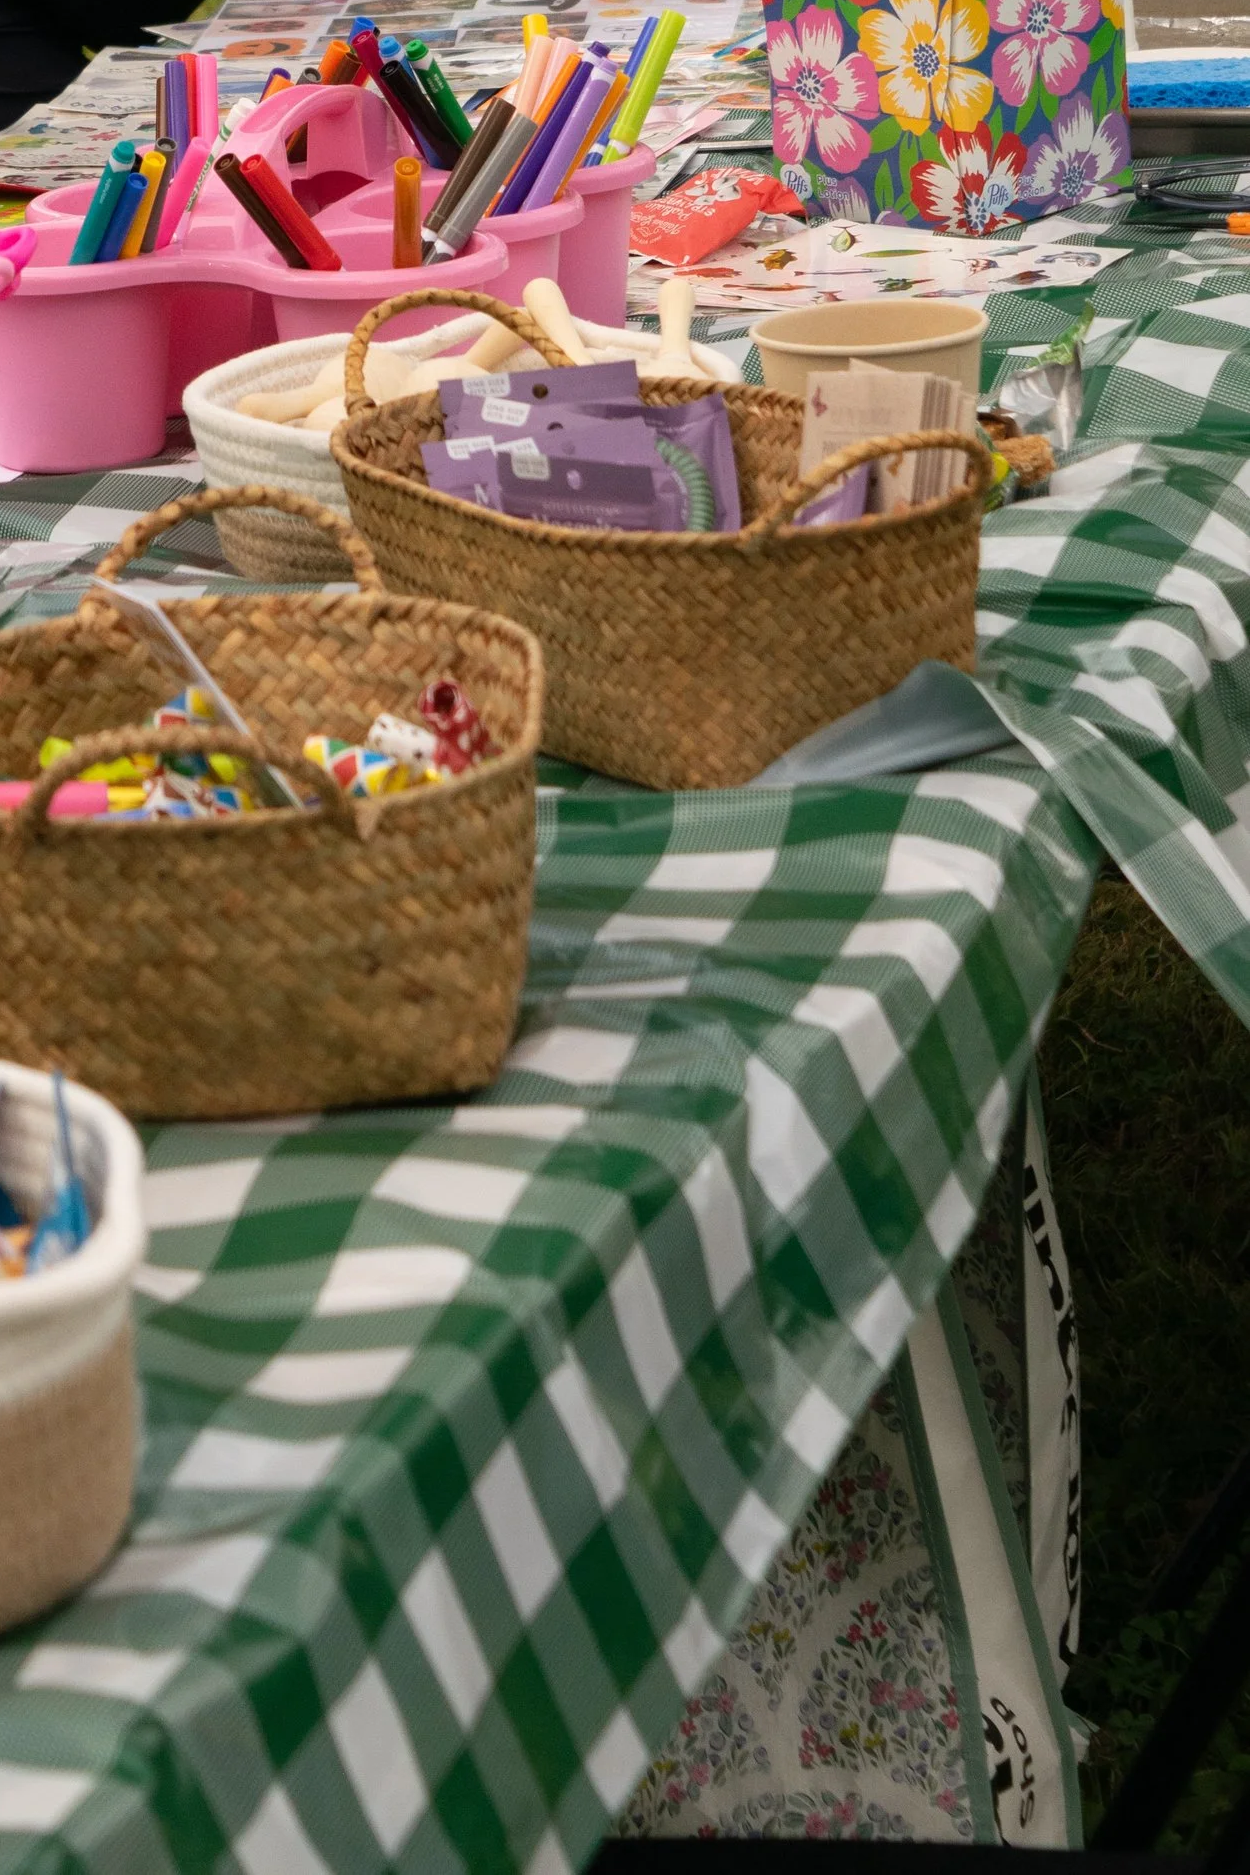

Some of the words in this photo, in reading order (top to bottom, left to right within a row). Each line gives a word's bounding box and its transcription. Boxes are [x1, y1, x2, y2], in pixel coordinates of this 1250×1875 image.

[784, 170, 808, 195] Puffs
[816, 174, 838, 186] Plus
[817, 188, 850, 200] Lotion
[988, 183, 1009, 207] Puffs
